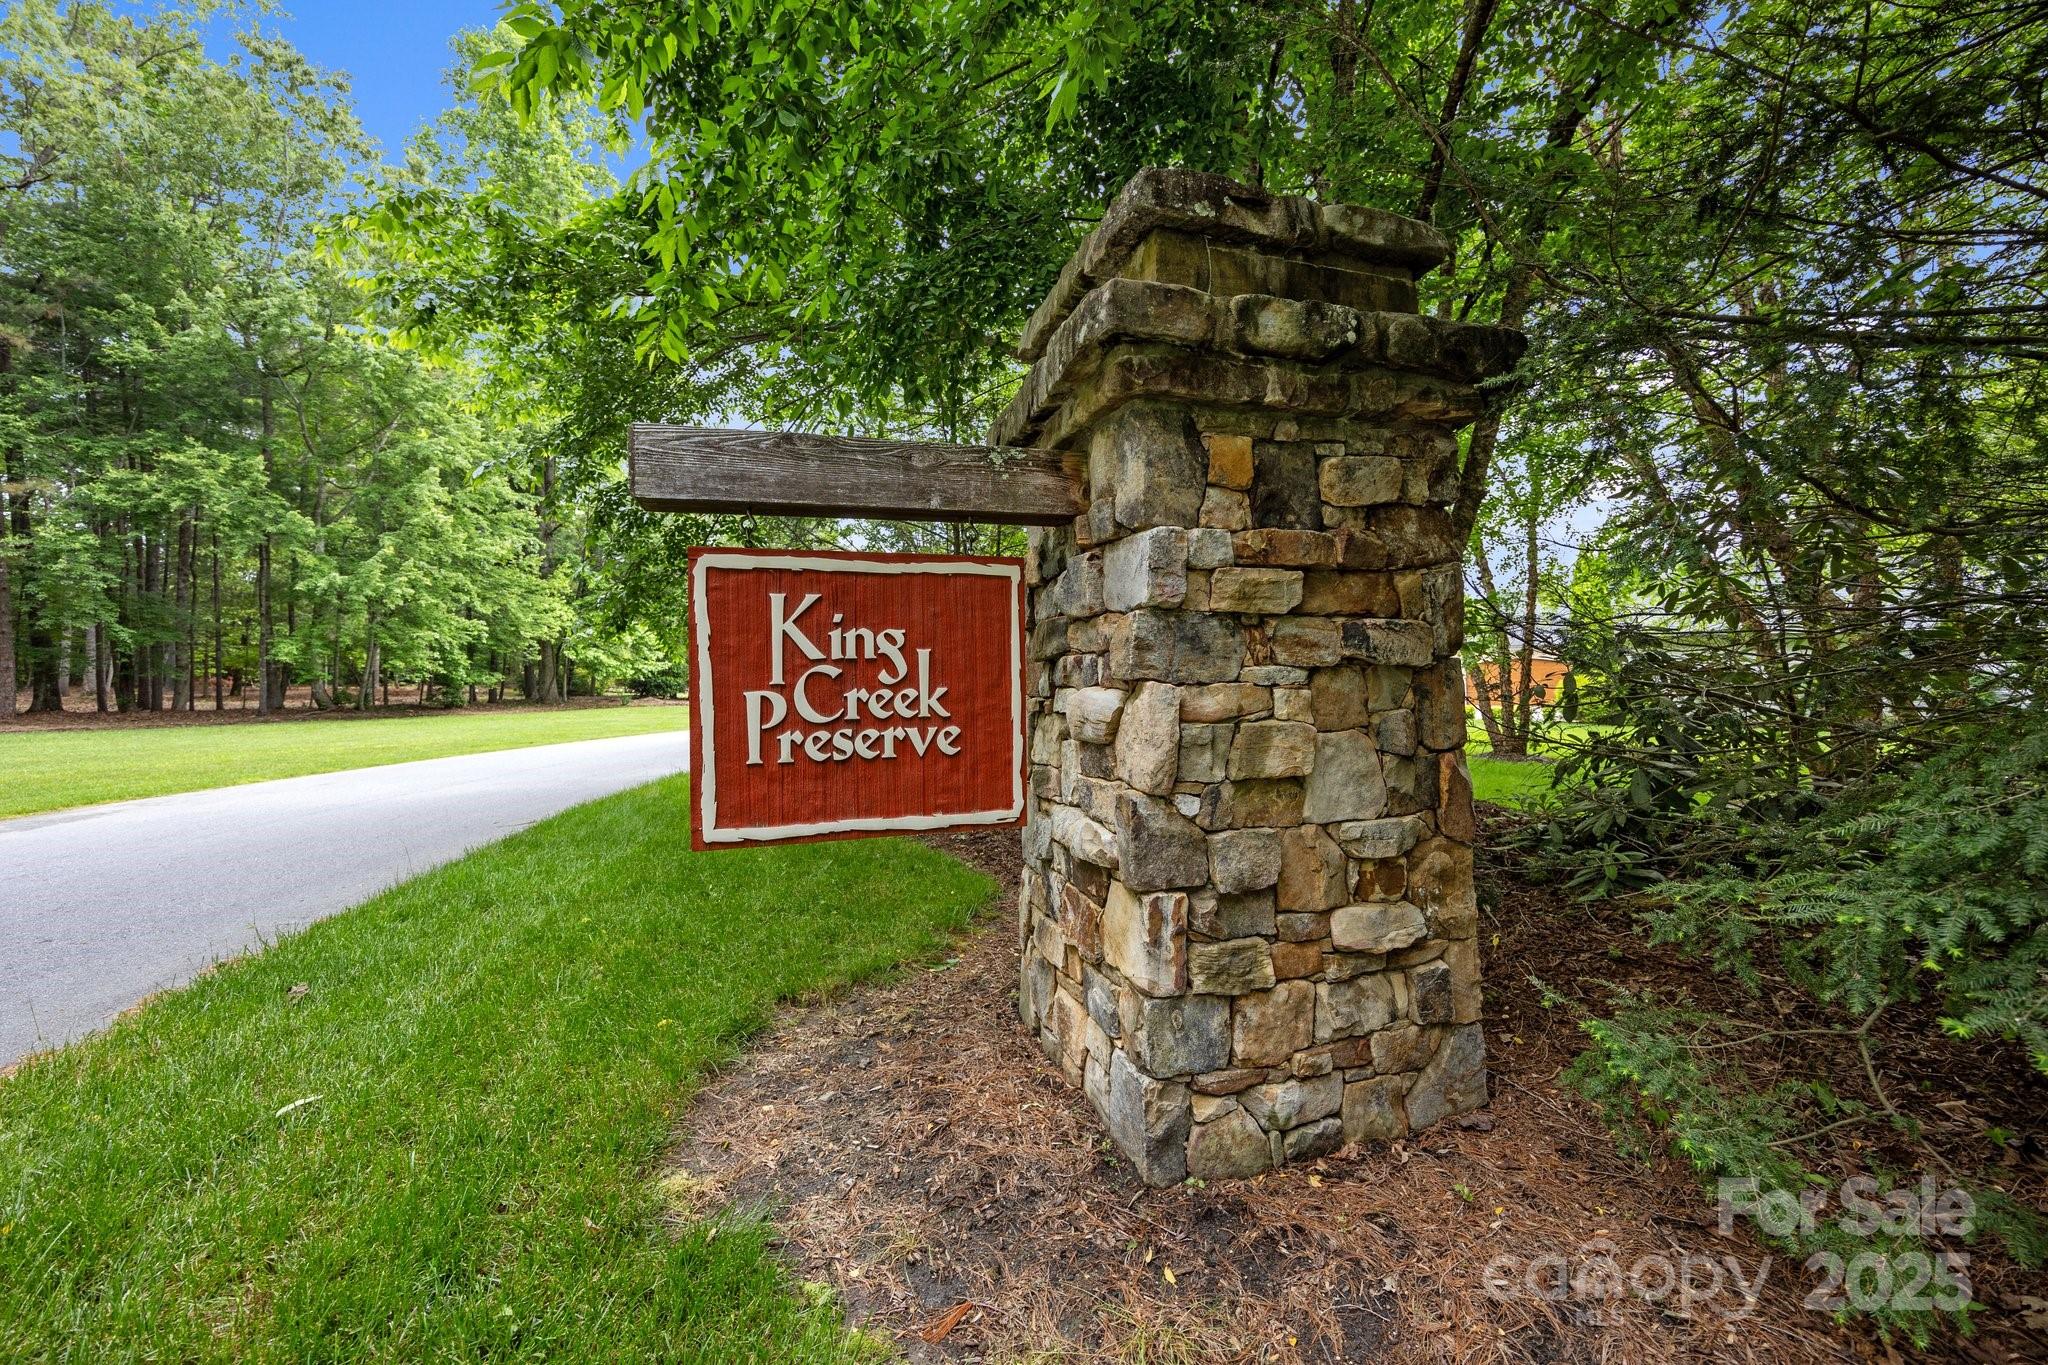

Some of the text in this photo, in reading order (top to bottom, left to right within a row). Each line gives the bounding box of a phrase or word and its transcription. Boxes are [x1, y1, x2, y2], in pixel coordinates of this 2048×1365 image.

[769, 592, 908, 686] King
[793, 648, 951, 724] Creek
[743, 690, 962, 765] Preserve
